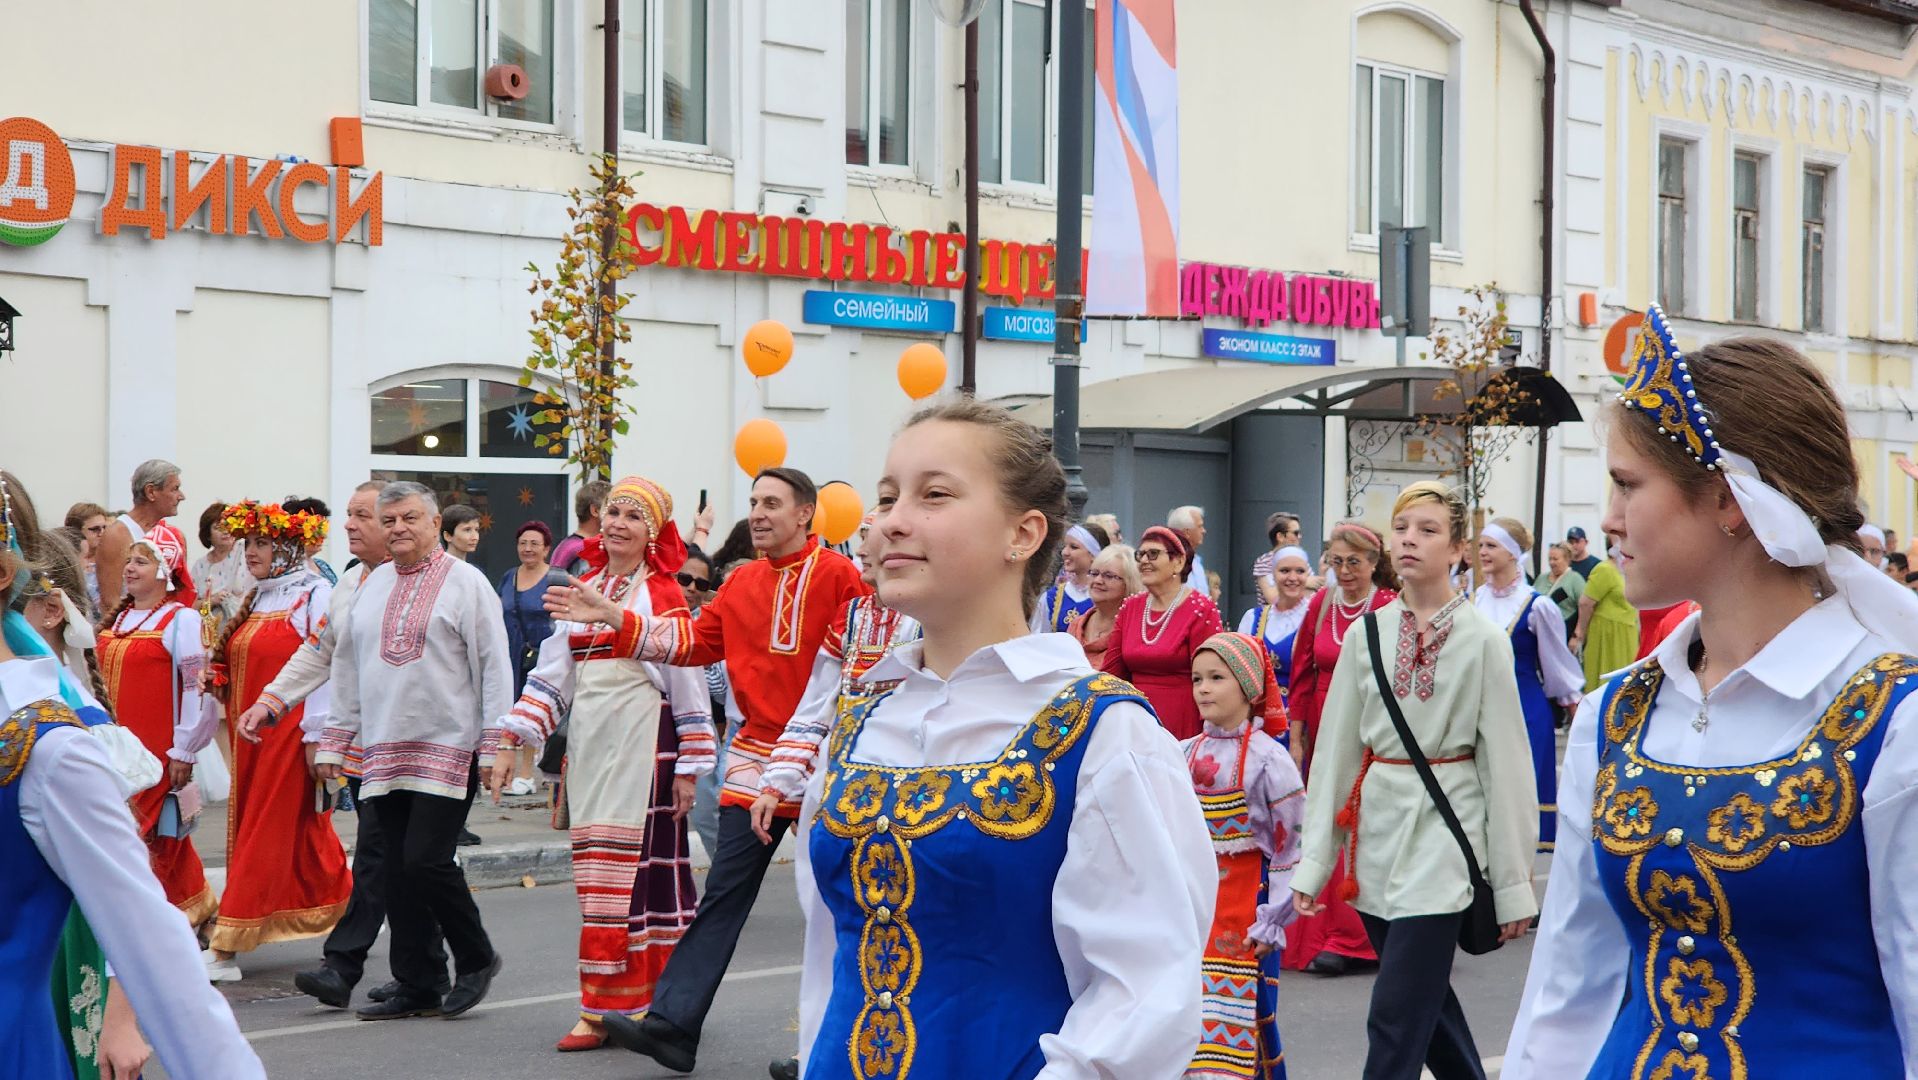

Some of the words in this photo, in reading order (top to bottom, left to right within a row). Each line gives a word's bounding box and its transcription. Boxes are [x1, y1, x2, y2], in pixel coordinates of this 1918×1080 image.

[0, 140, 49, 210] Д
[98, 144, 383, 246] ДИКСИ
[625, 203, 967, 290] СМЕШНЫЕ
[983, 239, 1088, 305] ЦЕ
[834, 298, 928, 323] семейный
[1004, 315, 1056, 335] магаз
[1181, 262, 1287, 327] ДЕЖДА
[1293, 274, 1380, 329] ОБУВЬ
[1218, 336, 1258, 353] ЭКОНОМ
[1260, 340, 1289, 356] КЛАСС
[1291, 343, 1296, 356] 2
[1298, 344, 1321, 359] ЭТАЖ
